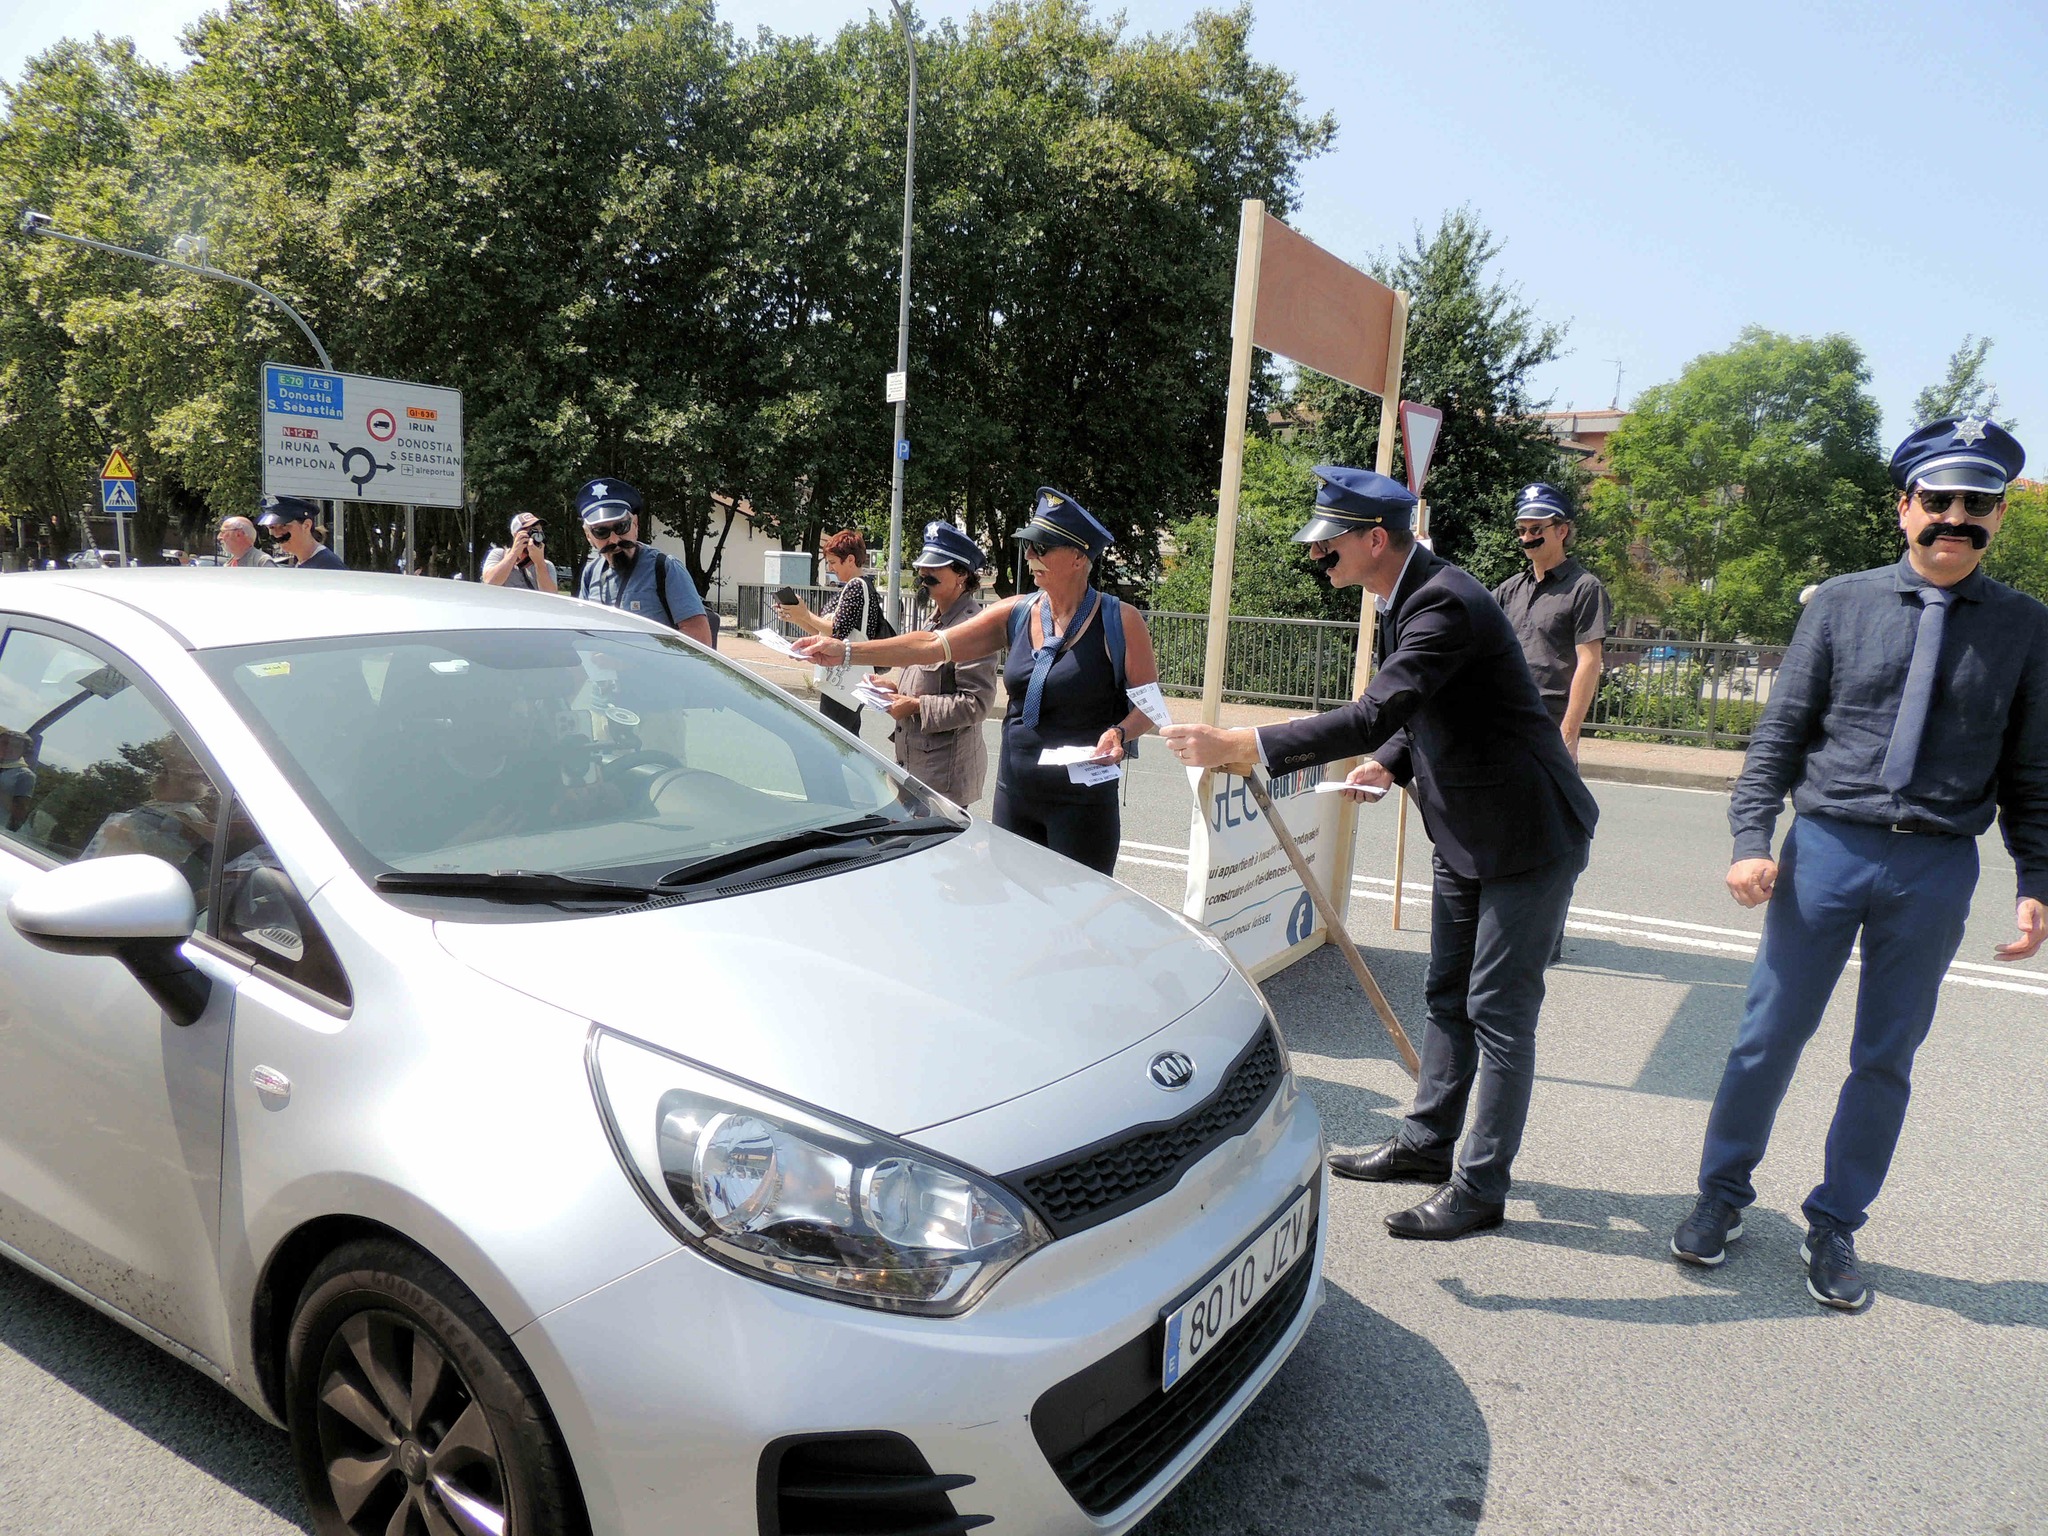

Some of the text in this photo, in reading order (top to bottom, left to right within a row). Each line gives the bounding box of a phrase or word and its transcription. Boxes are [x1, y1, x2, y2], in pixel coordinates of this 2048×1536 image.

[280, 375, 329, 389] E-70 A-8
[279, 388, 332, 403] Donostia
[268, 399, 343, 417] S. Sebastián
[409, 410, 435, 419] GI-636
[283, 427, 318, 439] N-121-A
[409, 422, 435, 433] IRUN
[281, 440, 320, 453] IRUÑA
[397, 438, 453, 452] DONOSTIA
[899, 443, 908, 458] P
[268, 455, 336, 470] PAMPLONA
[415, 467, 455, 477] aireportua
[1218, 855, 1255, 879] appartient
[1208, 885, 1244, 905] construire
[1152, 1052, 1193, 1086] KIA
[1189, 1203, 1305, 1356] 8010 JZV
